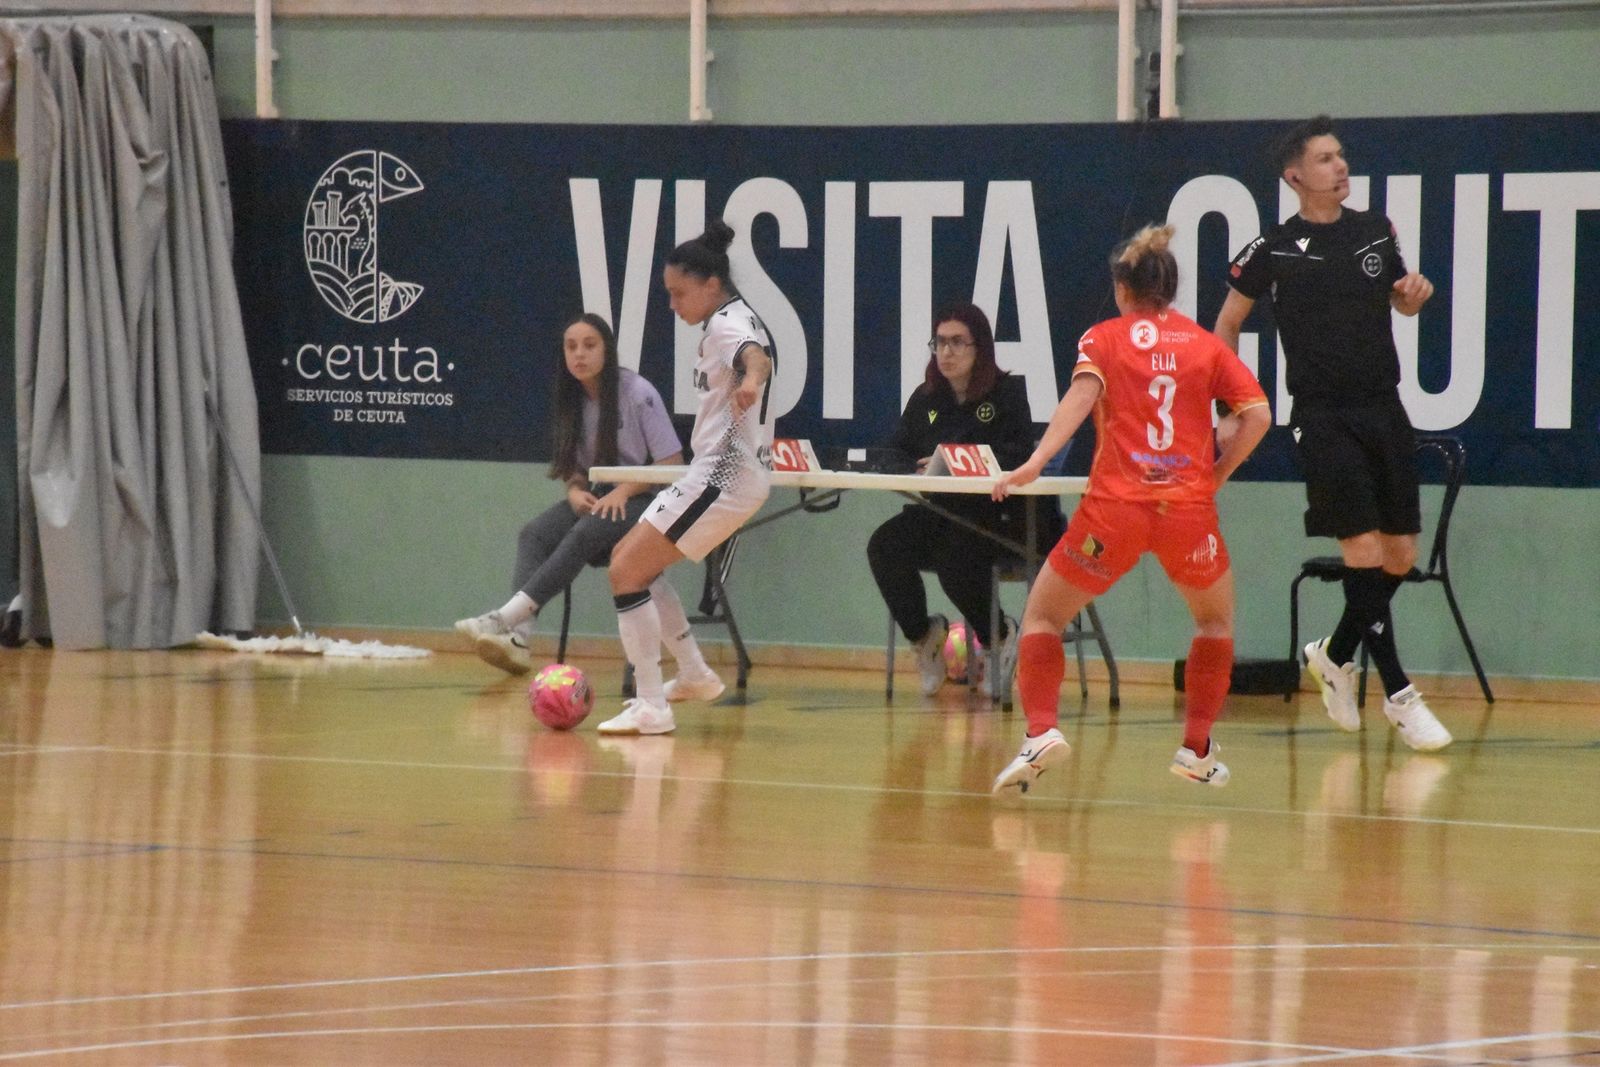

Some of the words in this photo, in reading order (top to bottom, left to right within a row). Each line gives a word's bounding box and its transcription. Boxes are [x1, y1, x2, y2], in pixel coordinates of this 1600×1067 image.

[569, 176, 1060, 424] VISITA
[1151, 352, 1177, 371] ELIA
[287, 388, 363, 404] SERVICIOS
[367, 388, 454, 406] TURÍSTICOS
[333, 409, 353, 421] DE
[356, 410, 406, 424] CEUTA
[1146, 374, 1177, 450] 3
[772, 441, 798, 468] 5
[944, 446, 977, 473] 5
